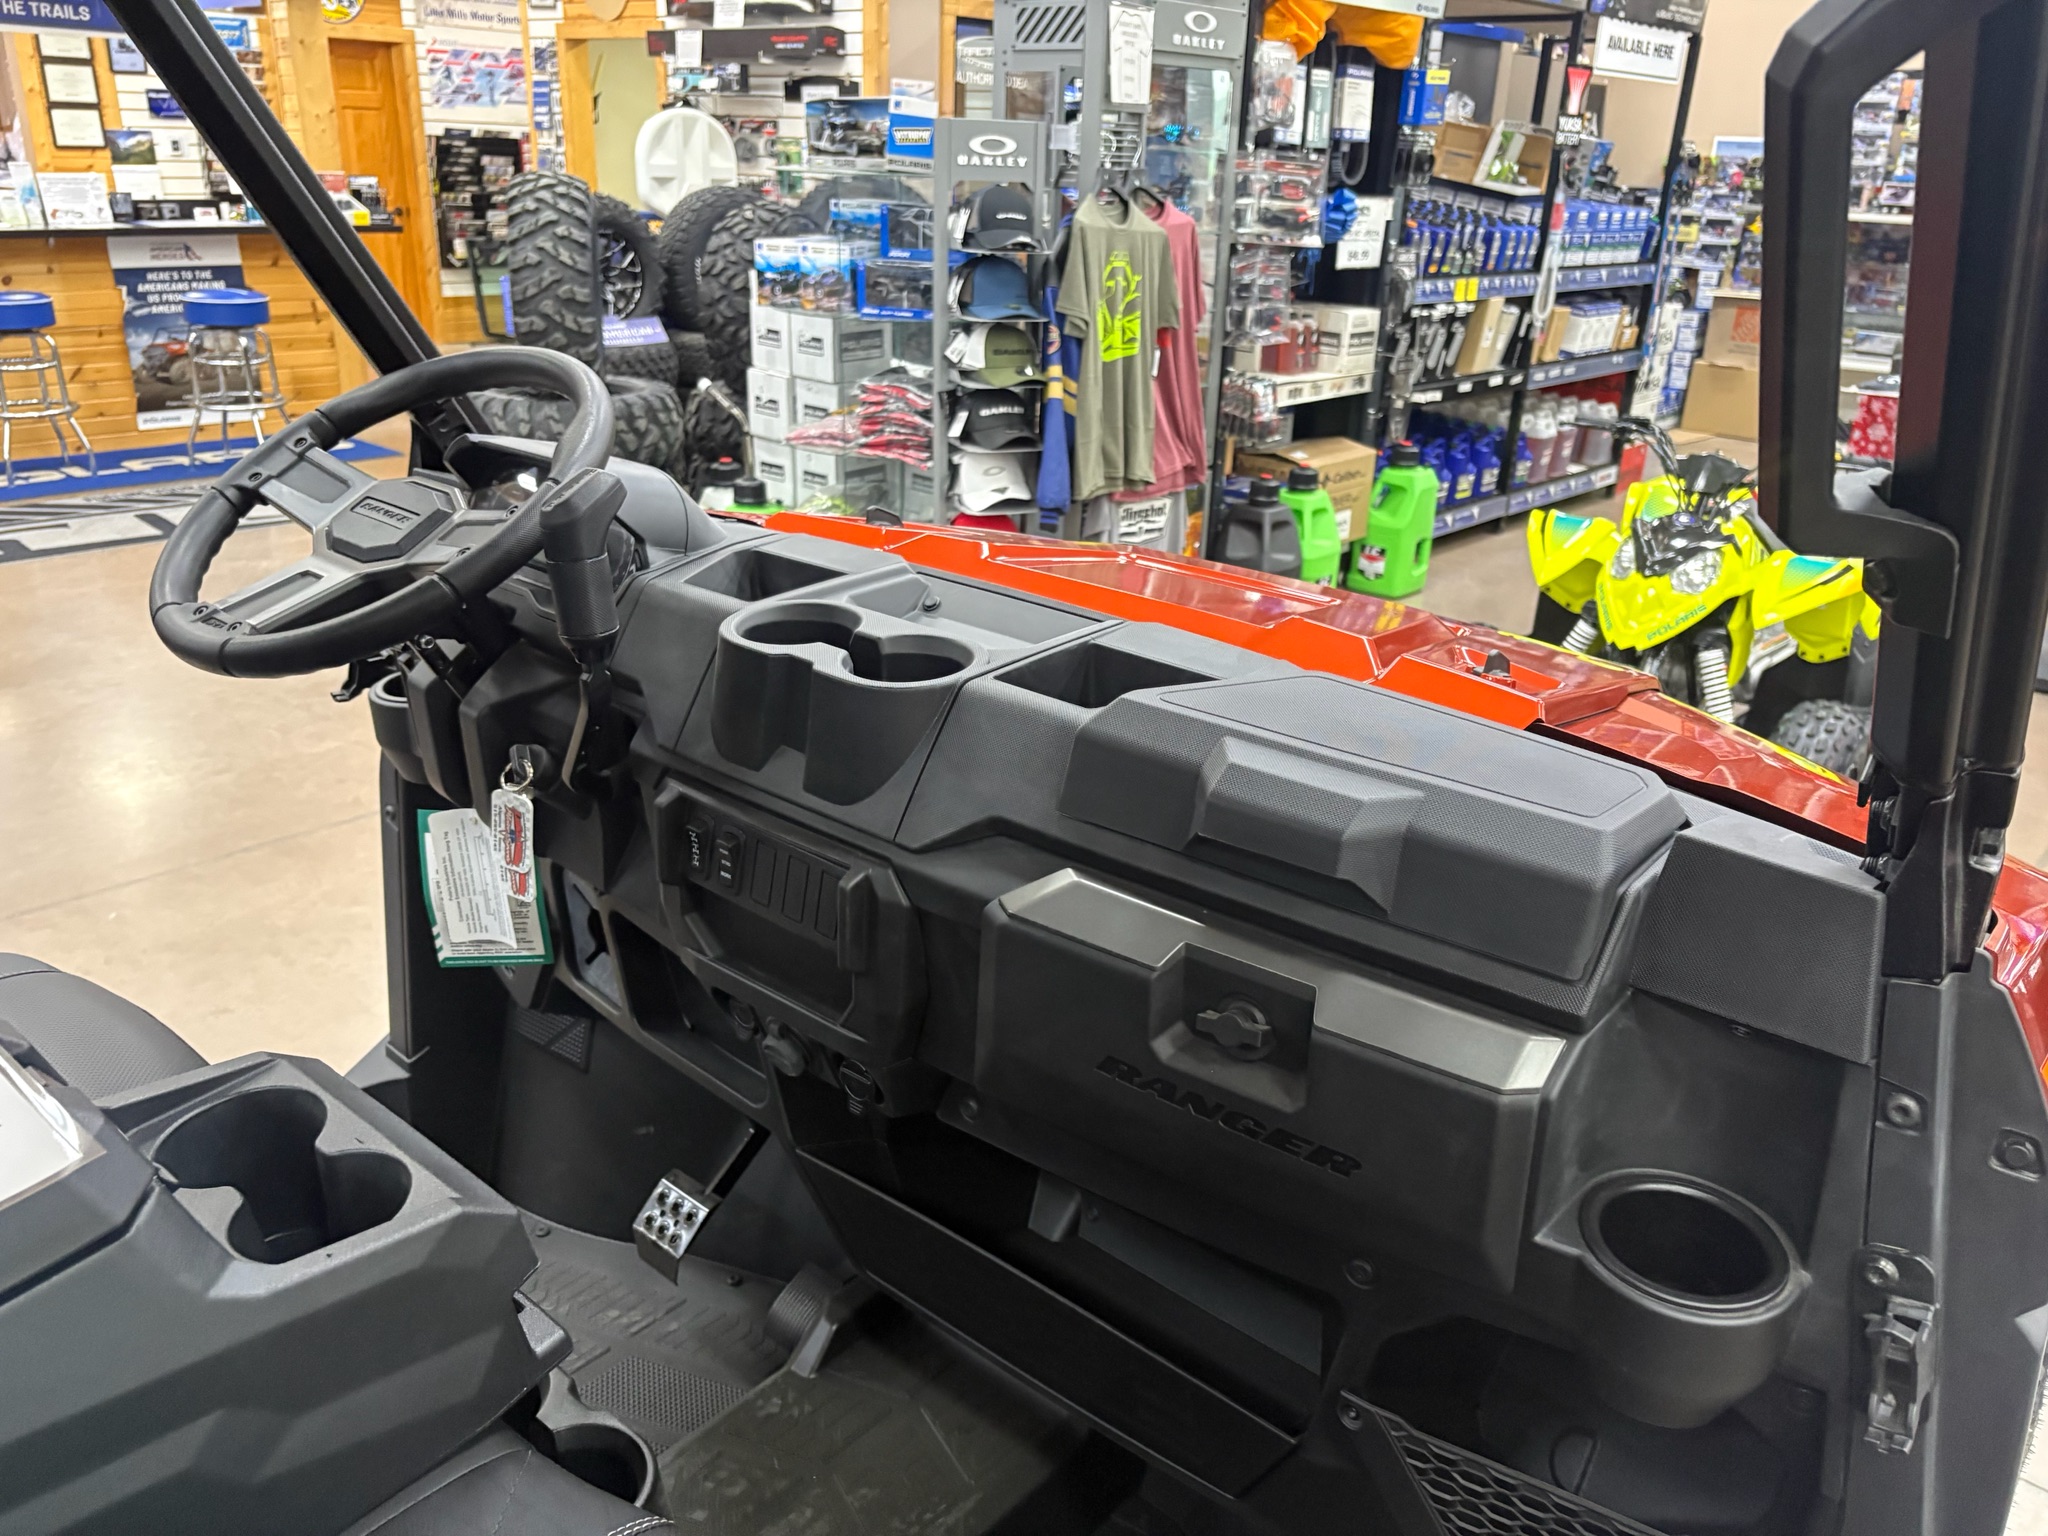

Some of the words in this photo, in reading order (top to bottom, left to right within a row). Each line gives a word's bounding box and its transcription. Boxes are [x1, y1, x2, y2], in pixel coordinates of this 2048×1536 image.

[0, 1, 26, 17] HE
[28, 2, 92, 22] TRAILS
[1172, 33, 1226, 51] OAKLEY
[1607, 34, 1652, 57] AVAILABLE
[1652, 43, 1675, 61] HERE
[956, 155, 1028, 168] OAKLEY
[146, 271, 179, 281] HERE'S
[181, 271, 194, 280] TO
[195, 270, 213, 280] THE
[137, 282, 189, 293] AMERICANS
[191, 280, 226, 290] MAKING
[147, 294, 160, 303] US
[360, 501, 412, 525] RANGER
[1646, 603, 1708, 642] POLARIS
[1095, 1056, 1363, 1178] RANGER
